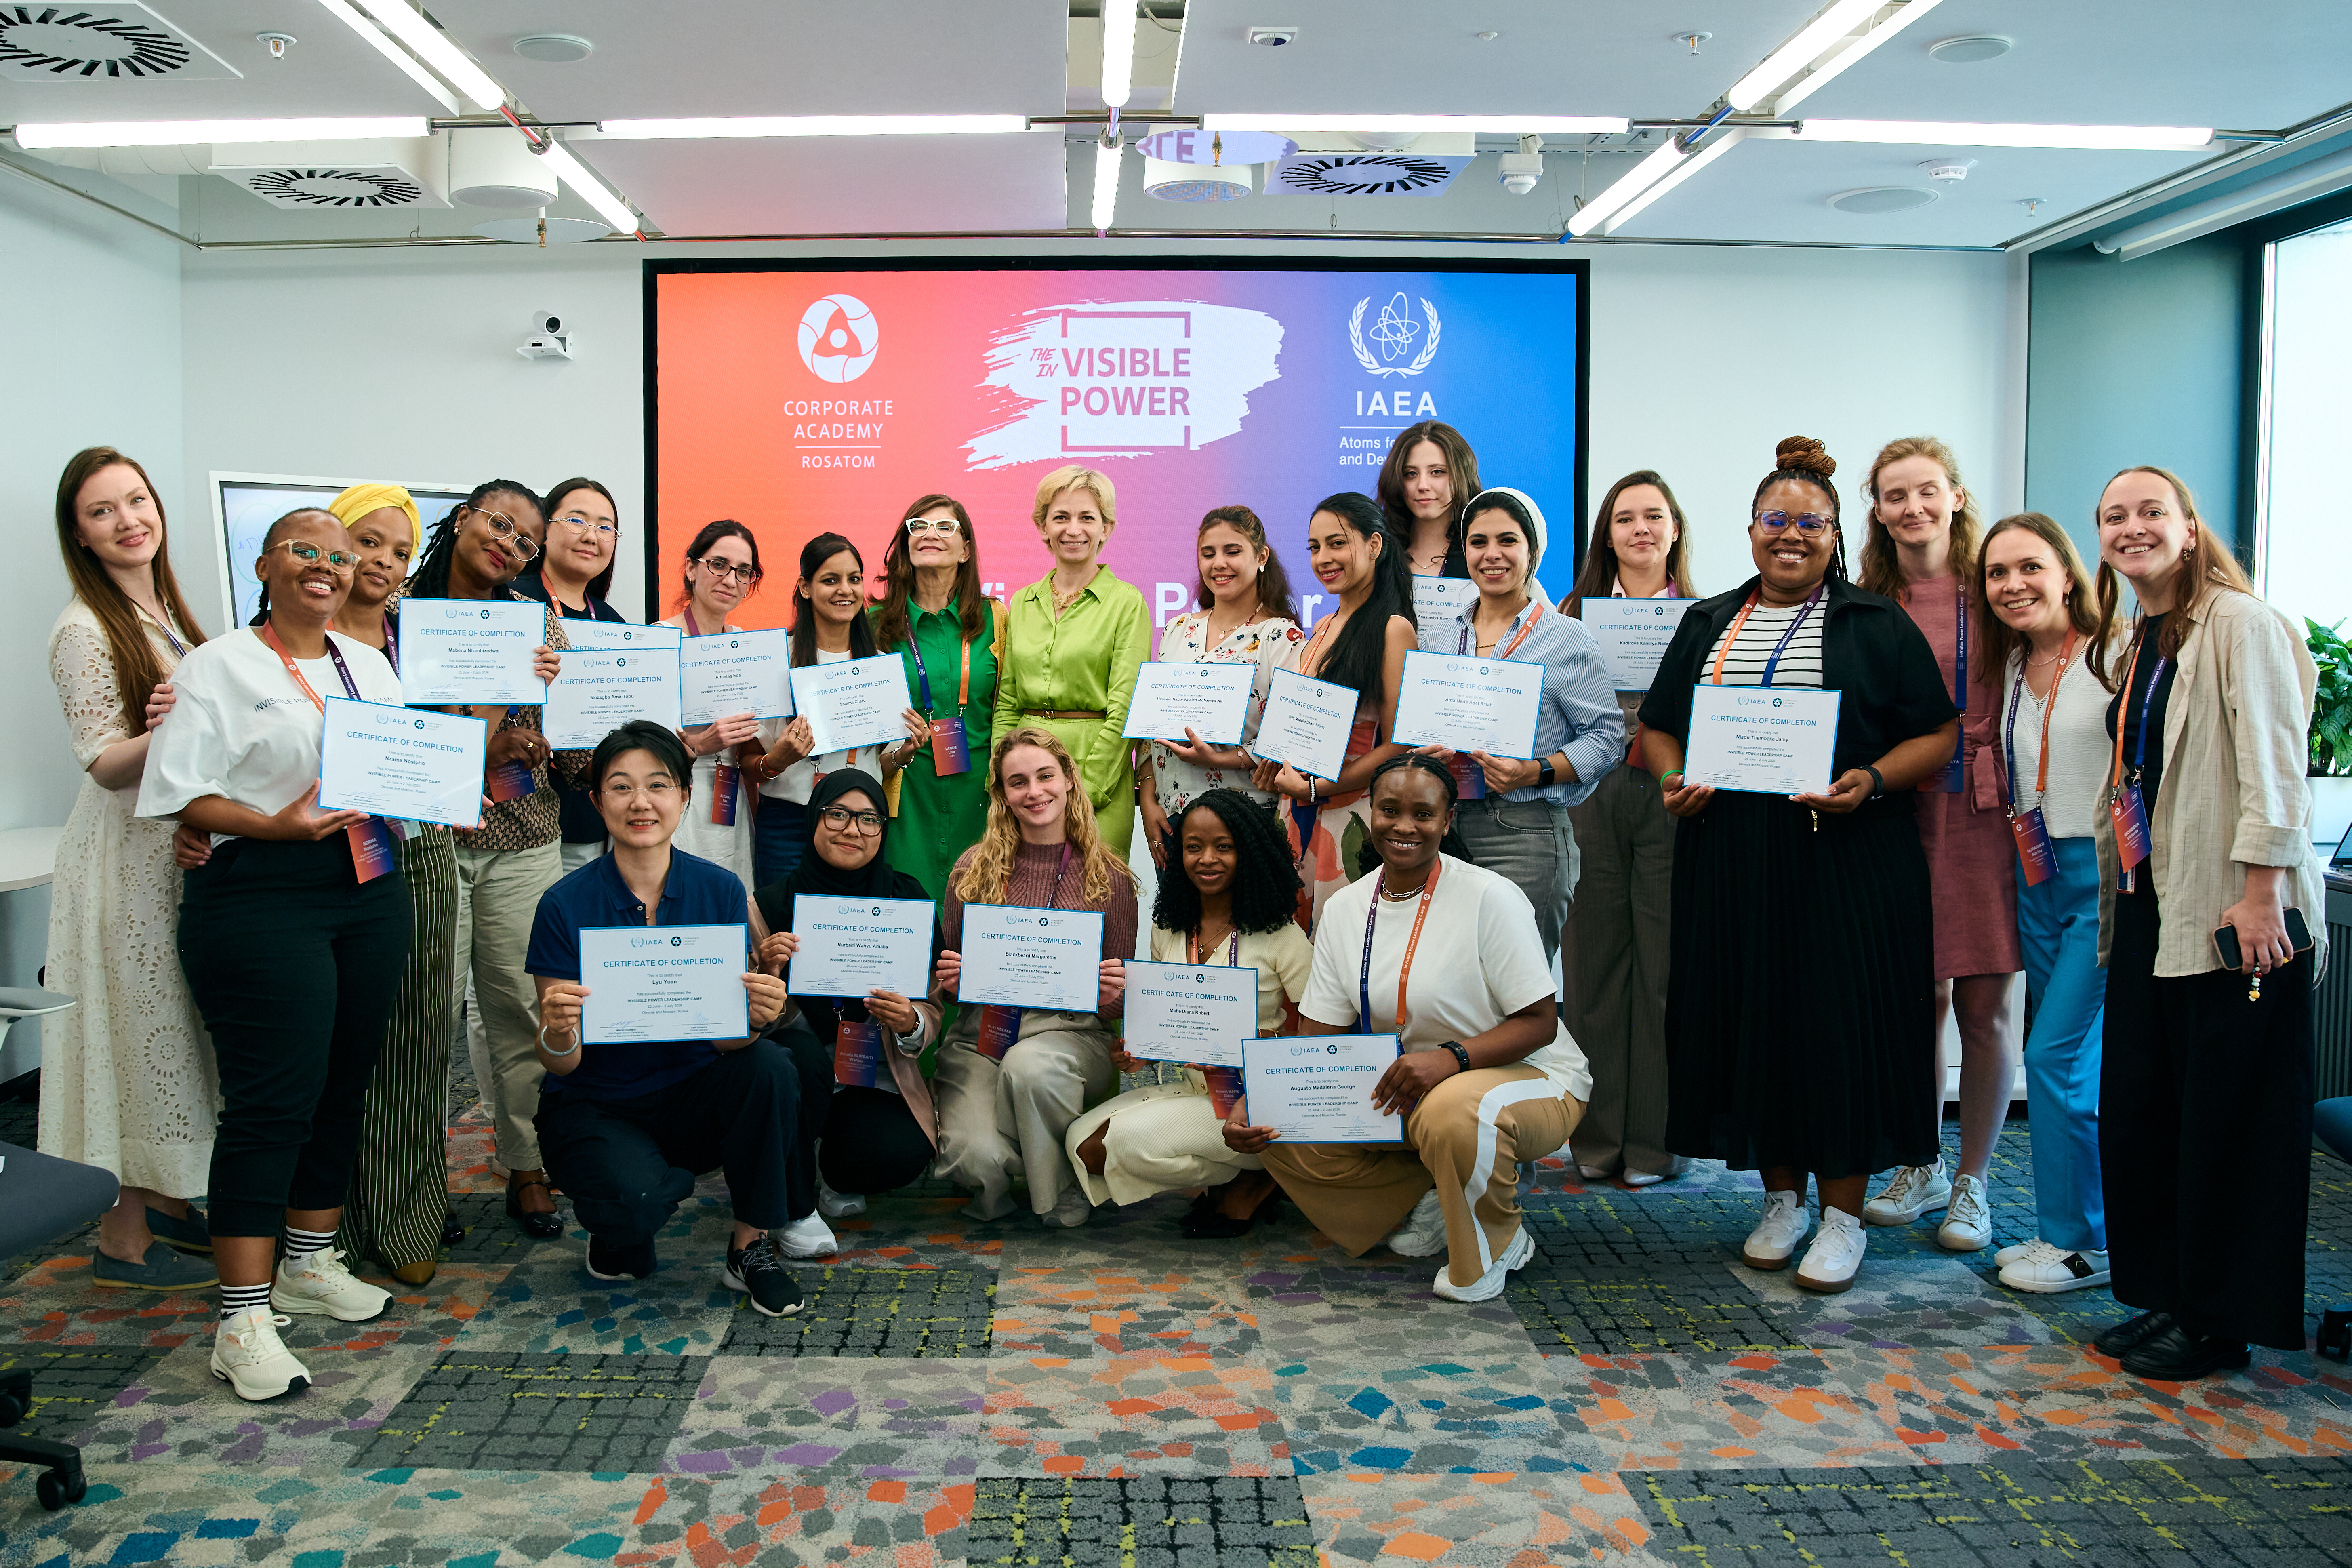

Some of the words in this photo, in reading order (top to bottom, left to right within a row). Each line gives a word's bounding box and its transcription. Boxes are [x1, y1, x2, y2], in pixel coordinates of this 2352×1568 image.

[1030, 348, 1056, 361] THE
[1036, 364, 1058, 377] IN
[1062, 347, 1190, 377] VISIBLE
[1061, 386, 1190, 415] POWER
[1357, 391, 1437, 416] IAEA
[784, 401, 893, 415] CORPORATE
[794, 423, 883, 438] ACADEMY
[1340, 437, 1380, 448] Atoms
[802, 456, 875, 468] ROSATOM
[1339, 453, 1362, 465] and
[681, 659, 721, 668] CERTIFICATE
[732, 655, 771, 663] COMPLETION
[809, 687, 844, 697] CERTIFICATE
[855, 679, 891, 689] COMPLETION
[1421, 679, 1464, 688] CERTIFICATE
[1477, 685, 1521, 695] COMPLETION
[254, 698, 293, 713] INVISIBLE
[1280, 696, 1306, 708] CERTIFICATE
[1313, 706, 1341, 719] COMPLETION
[1711, 715, 1757, 723] CERTIFICATE
[347, 731, 398, 744] CERTIFICATE
[413, 741, 463, 753] COMPLETION
[1413, 918, 1422, 939] Leadership
[981, 933, 1025, 941] CERTIFICATE
[1038, 937, 1082, 945] COMPLETION
[604, 960, 656, 968] CERTIFICATE
[671, 958, 723, 966] COMPLETION
[1142, 989, 1183, 998] CERTIFICATE
[1195, 993, 1238, 1002] COMPLETION
[988, 1024, 1012, 1033] BLACKBEARD
[1266, 1067, 1314, 1075] CERTIFICATE
